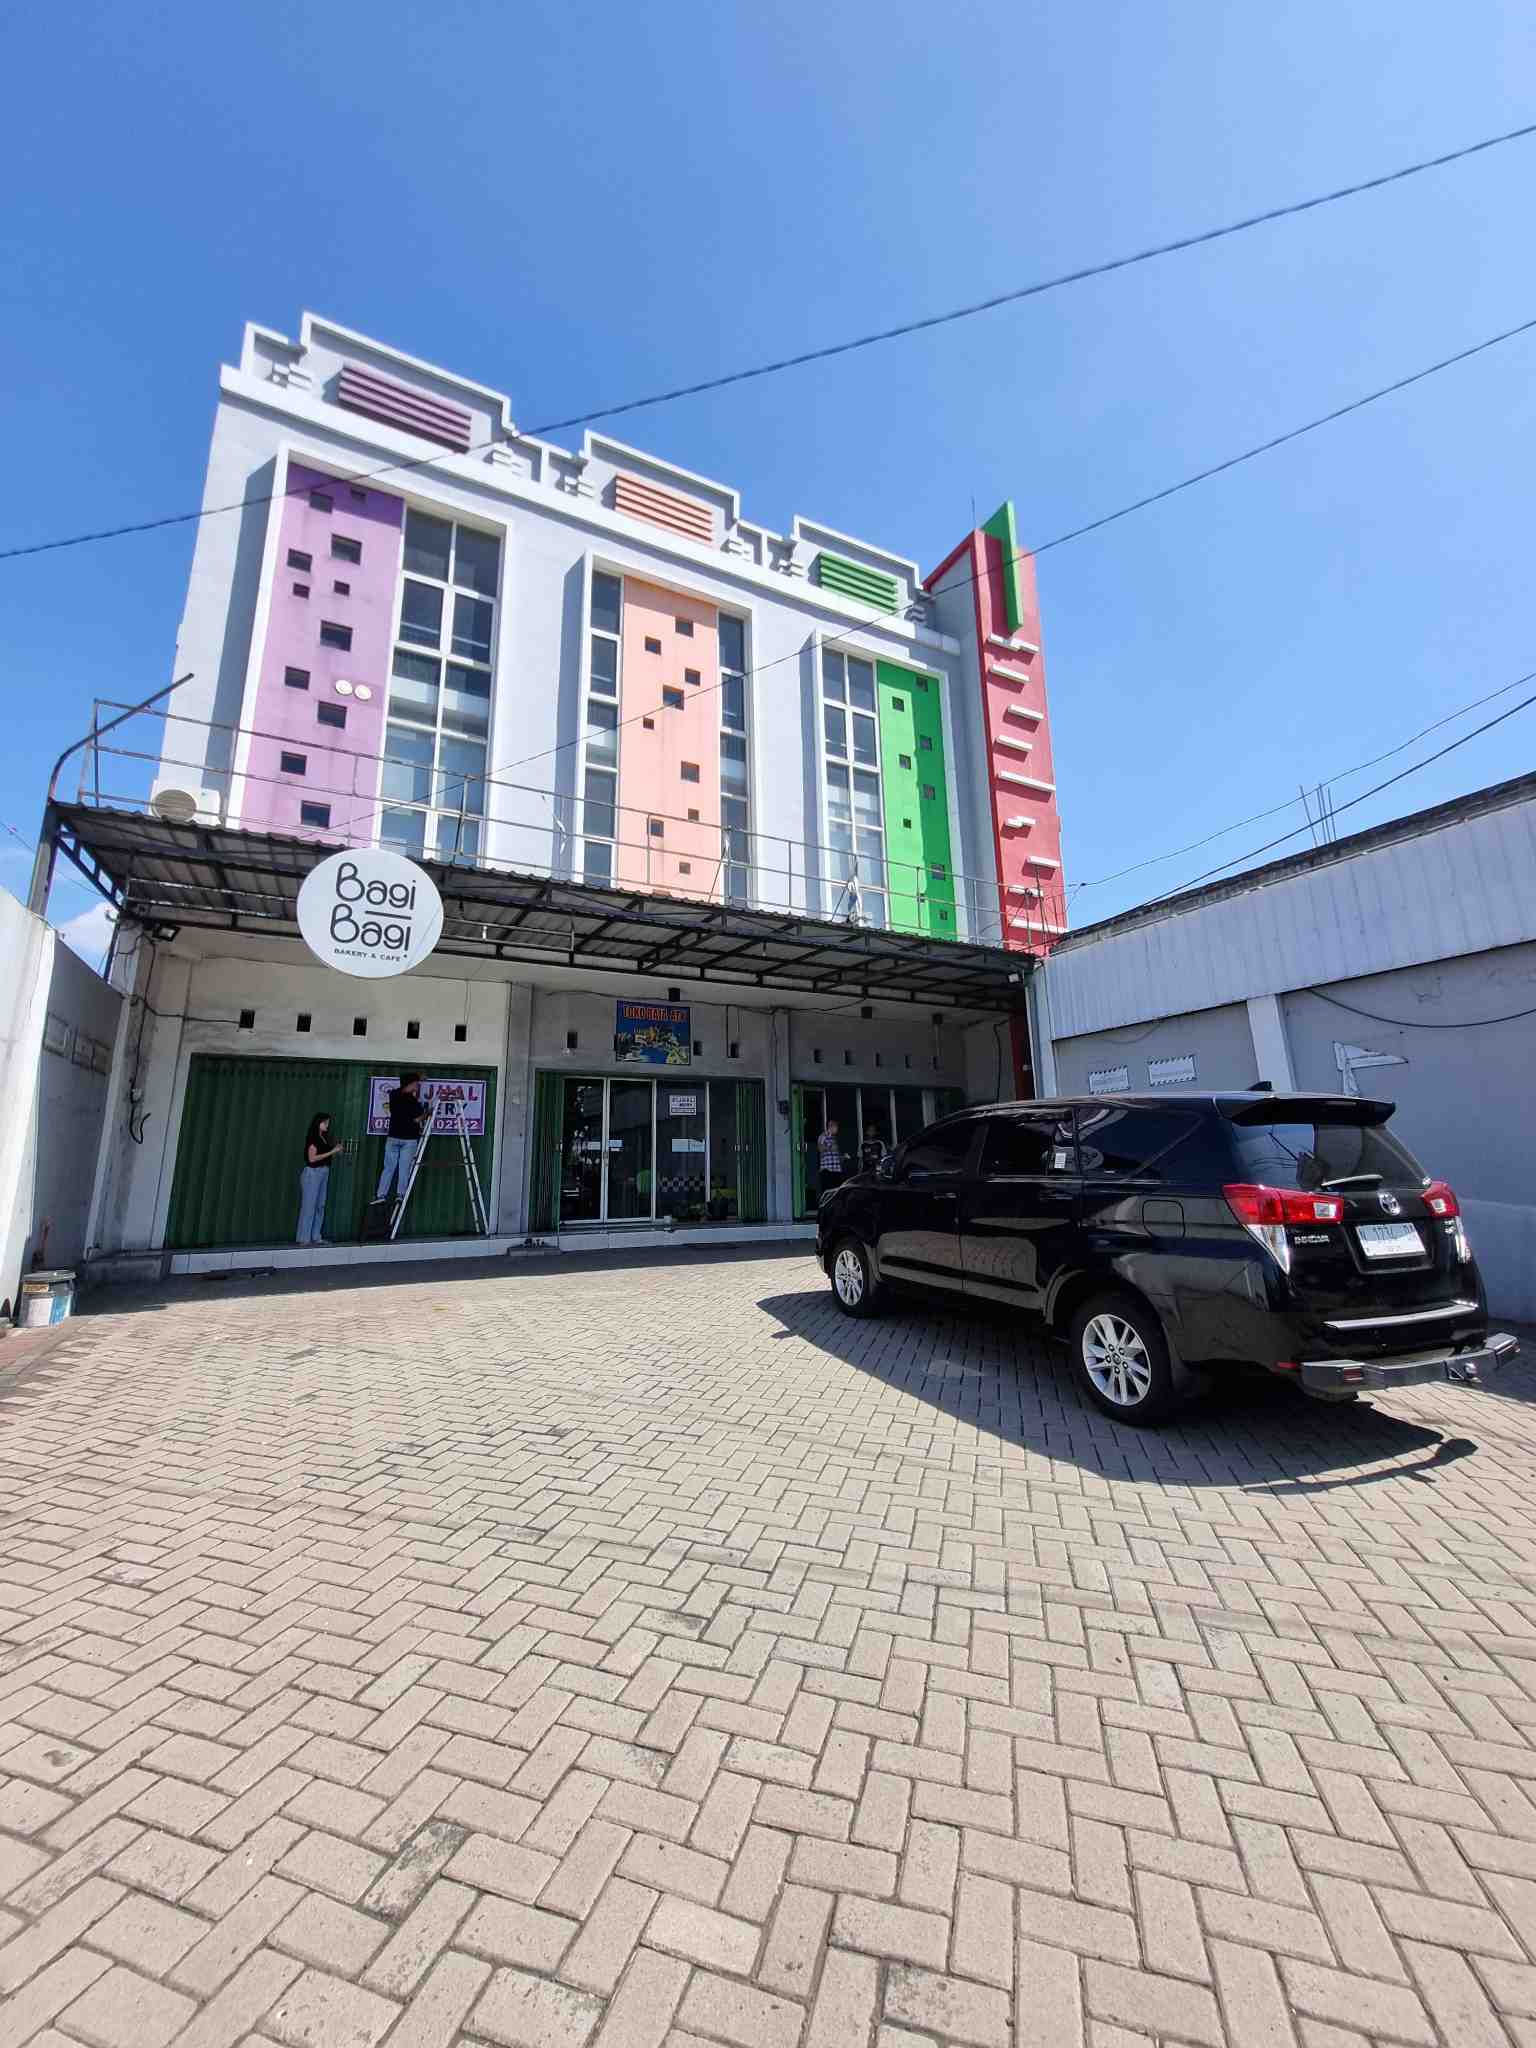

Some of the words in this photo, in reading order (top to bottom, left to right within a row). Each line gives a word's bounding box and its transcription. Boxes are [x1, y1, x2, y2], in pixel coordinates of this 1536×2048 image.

[336, 862, 416, 910] Bagi
[330, 903, 411, 958] Bagi
[334, 948, 367, 959] BAKERY
[380, 953, 401, 962] CAFE
